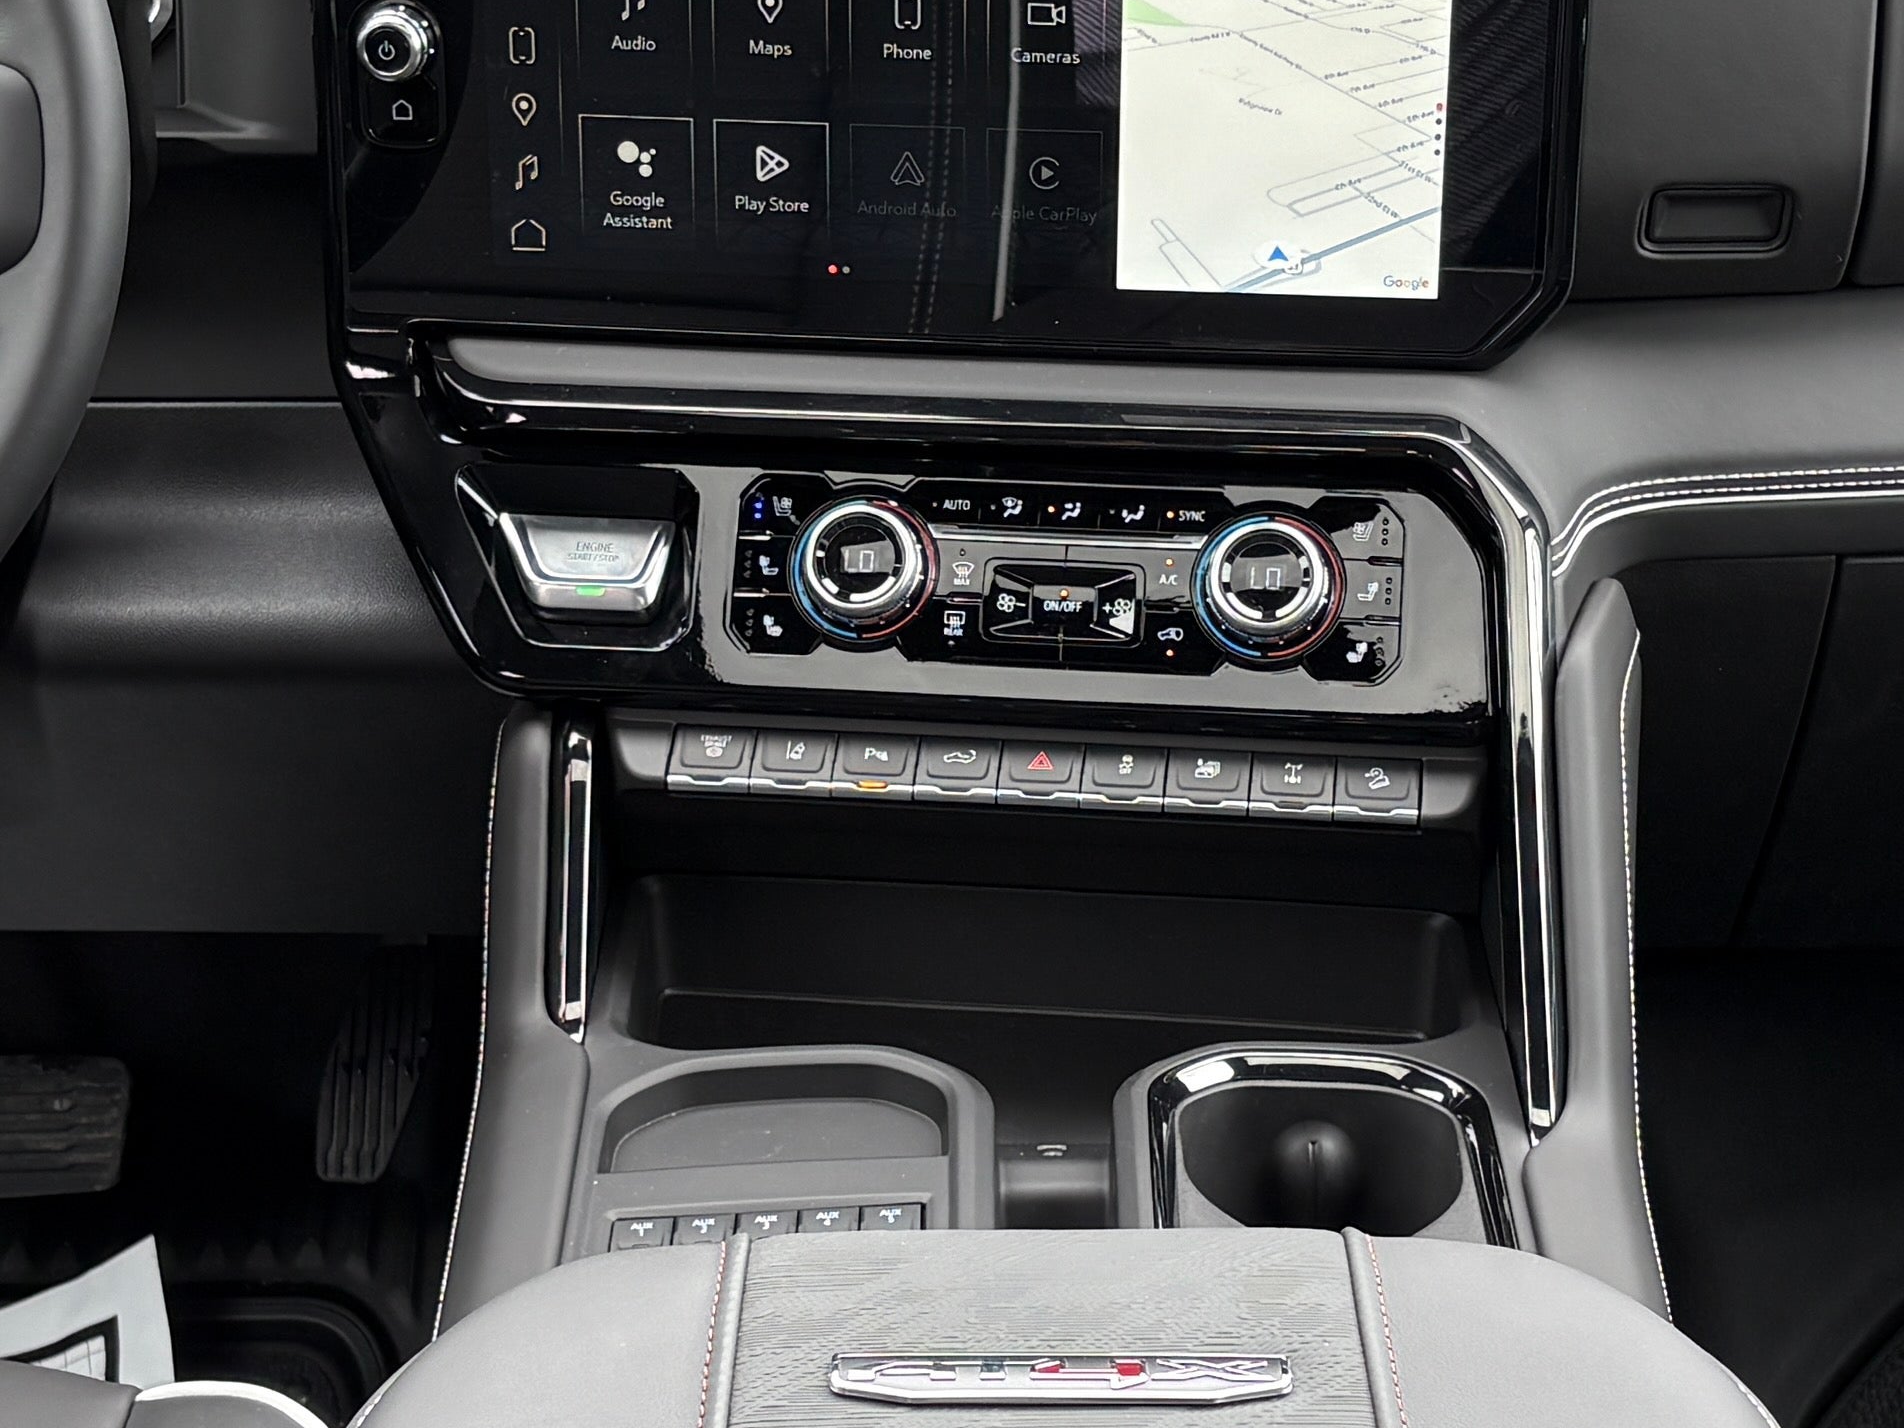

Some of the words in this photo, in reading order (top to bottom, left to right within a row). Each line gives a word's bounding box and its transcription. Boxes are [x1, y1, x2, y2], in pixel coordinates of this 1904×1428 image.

[611, 35, 657, 52] Audio
[749, 39, 793, 58] Maps
[882, 44, 932, 62] Phone
[1011, 48, 1081, 65] Cameras
[609, 191, 665, 210] Google
[735, 196, 766, 215] Play
[770, 197, 810, 213] Store
[857, 200, 917, 217] Android
[921, 201, 957, 218] Auto
[1038, 206, 1097, 225] CarPlay
[602, 213, 673, 229] Assistant
[1383, 275, 1429, 291] Google
[943, 499, 971, 511] AUTO
[1178, 509, 1206, 522] SYNC
[575, 541, 615, 553] ENGINE
[1158, 574, 1178, 586] A/C
[1043, 601, 1083, 613] ON/OFF
[754, 1215, 778, 1223] AUX
[816, 1211, 840, 1220] AUX
[879, 1208, 902, 1216] AUX
[630, 1222, 654, 1230] AUX
[692, 1218, 715, 1227] AUX
